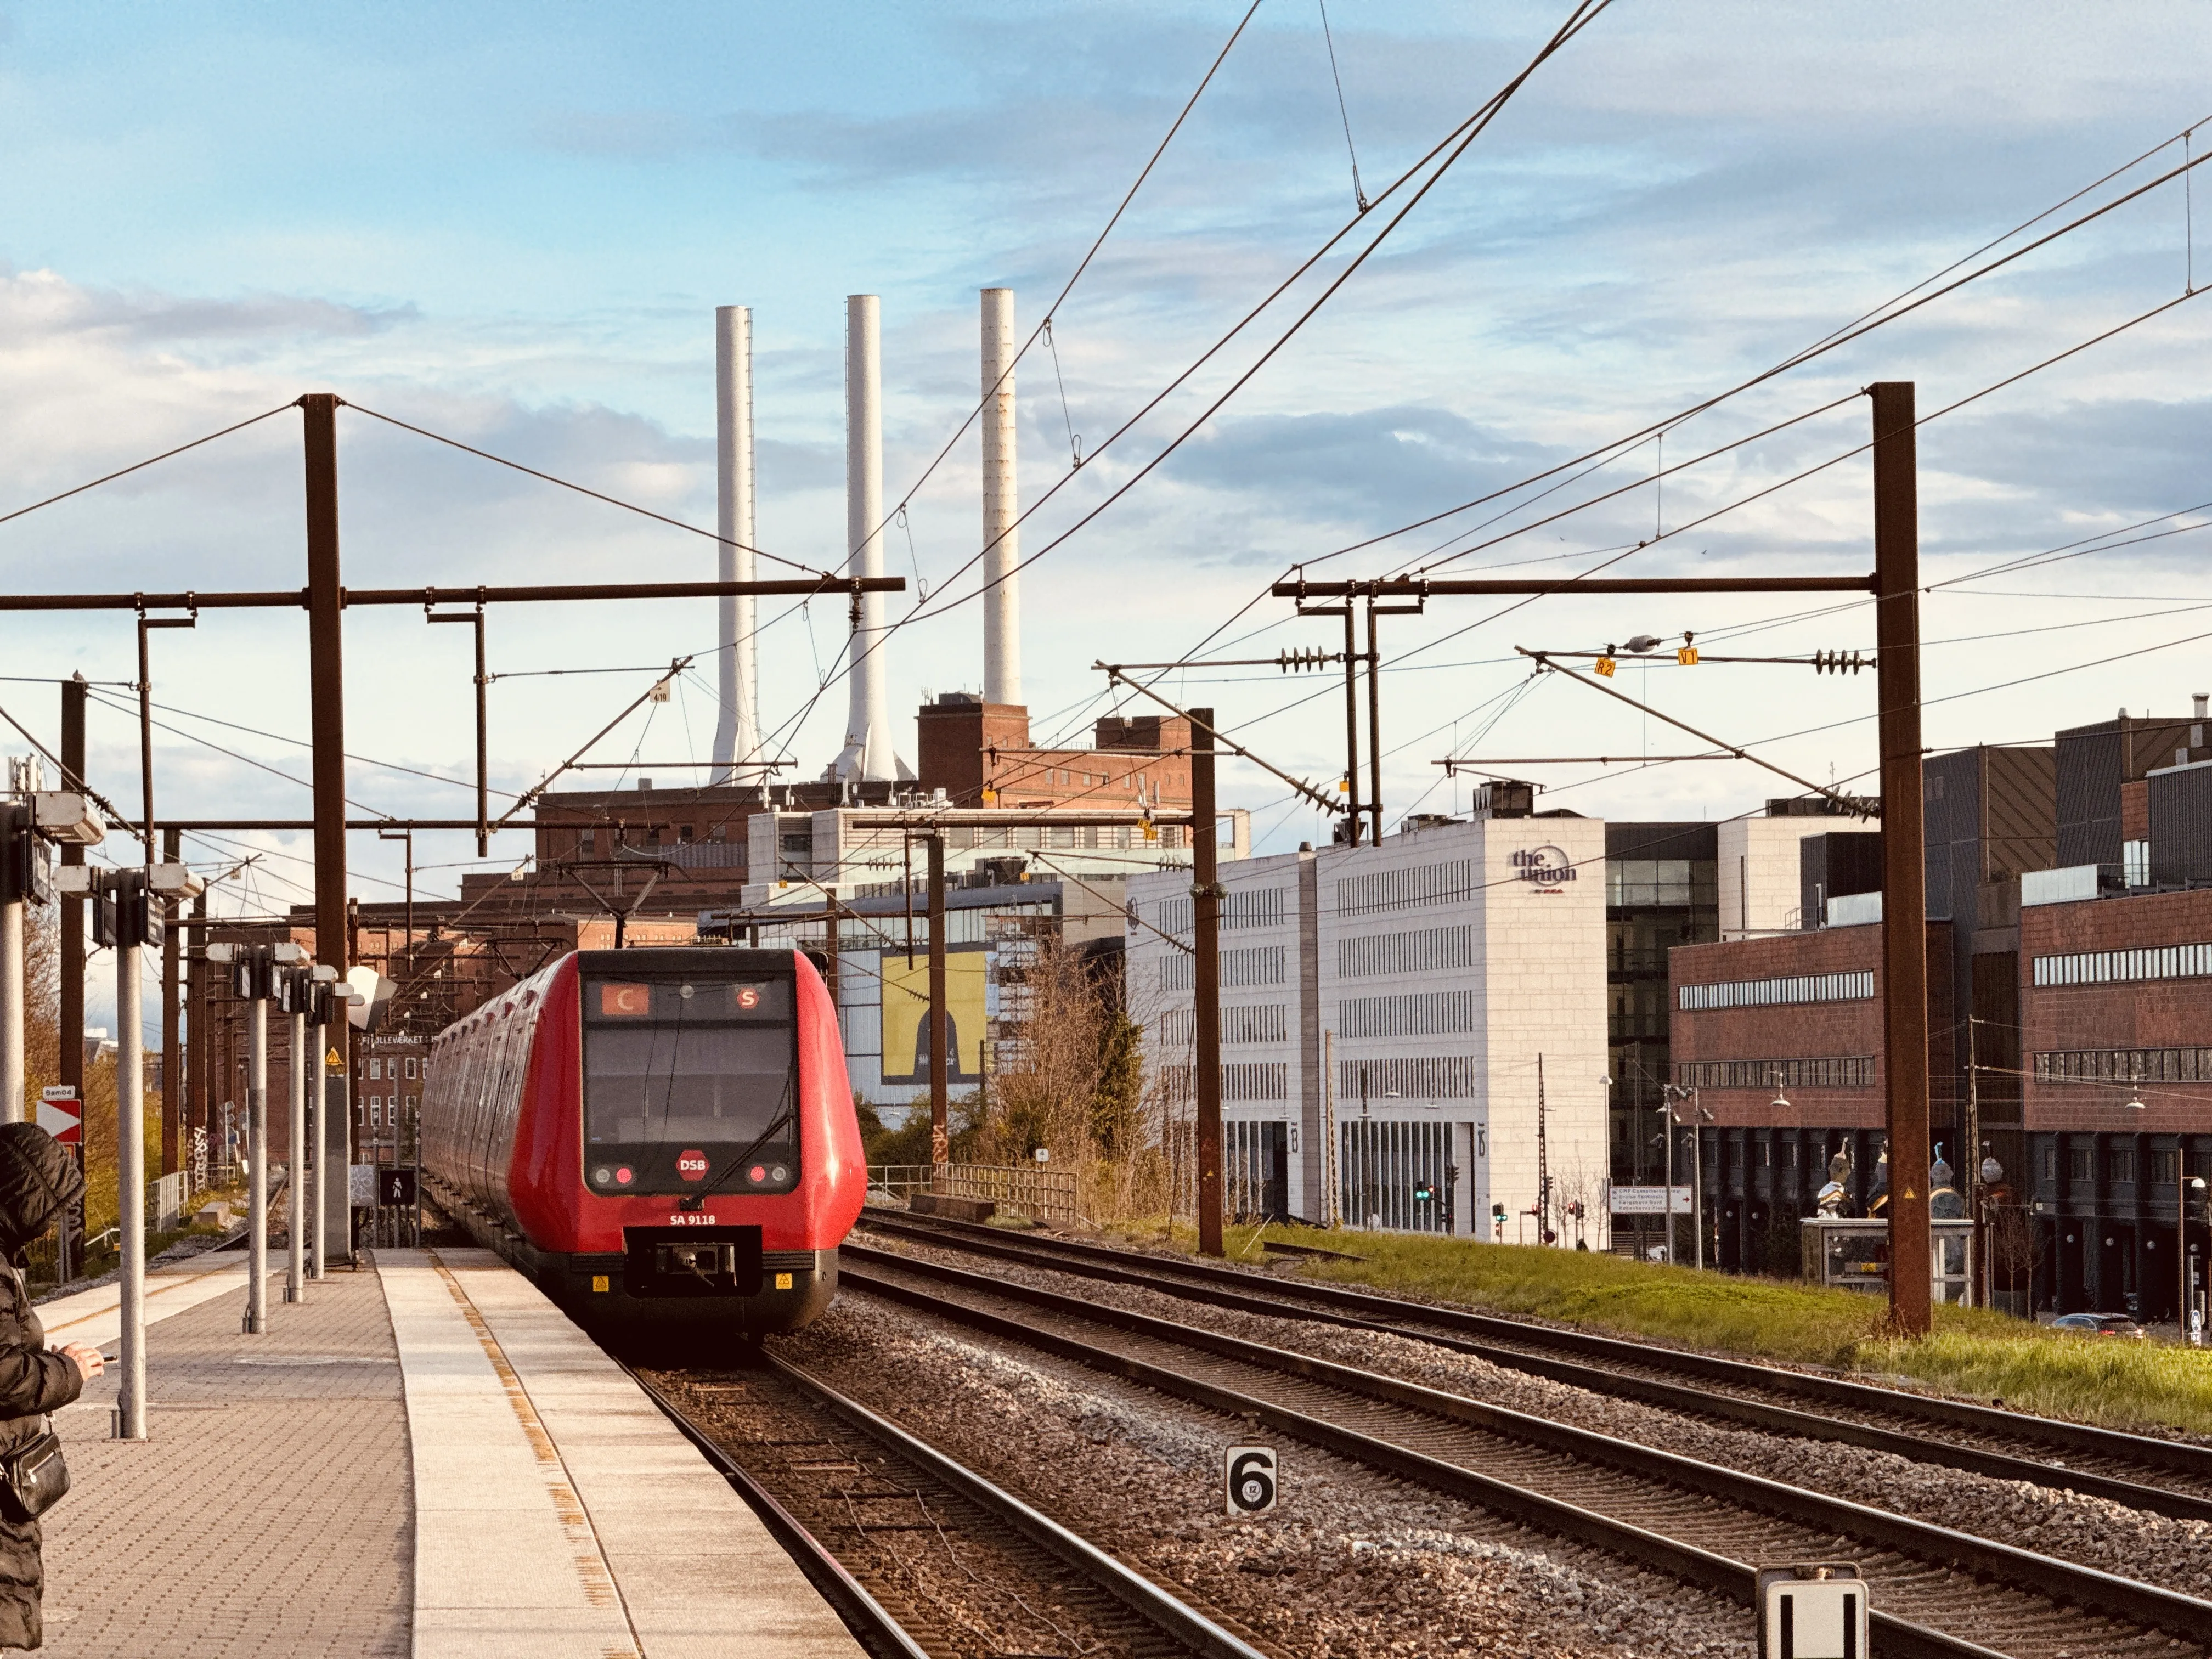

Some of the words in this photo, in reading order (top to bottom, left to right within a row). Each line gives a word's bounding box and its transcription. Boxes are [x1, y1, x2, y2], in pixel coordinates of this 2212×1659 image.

[1598, 662, 1612, 676] R2
[654, 693, 667, 702] 4/19
[1514, 849, 1545, 866] the
[1521, 864, 1577, 881] union
[617, 989, 633, 1011] C
[742, 991, 755, 1005] S
[680, 1160, 706, 1170] DSB
[670, 1215, 685, 1226] SA
[688, 1215, 716, 1226] 9118
[1229, 1452, 1274, 1511] 6
[1248, 1485, 1257, 1493] 12
